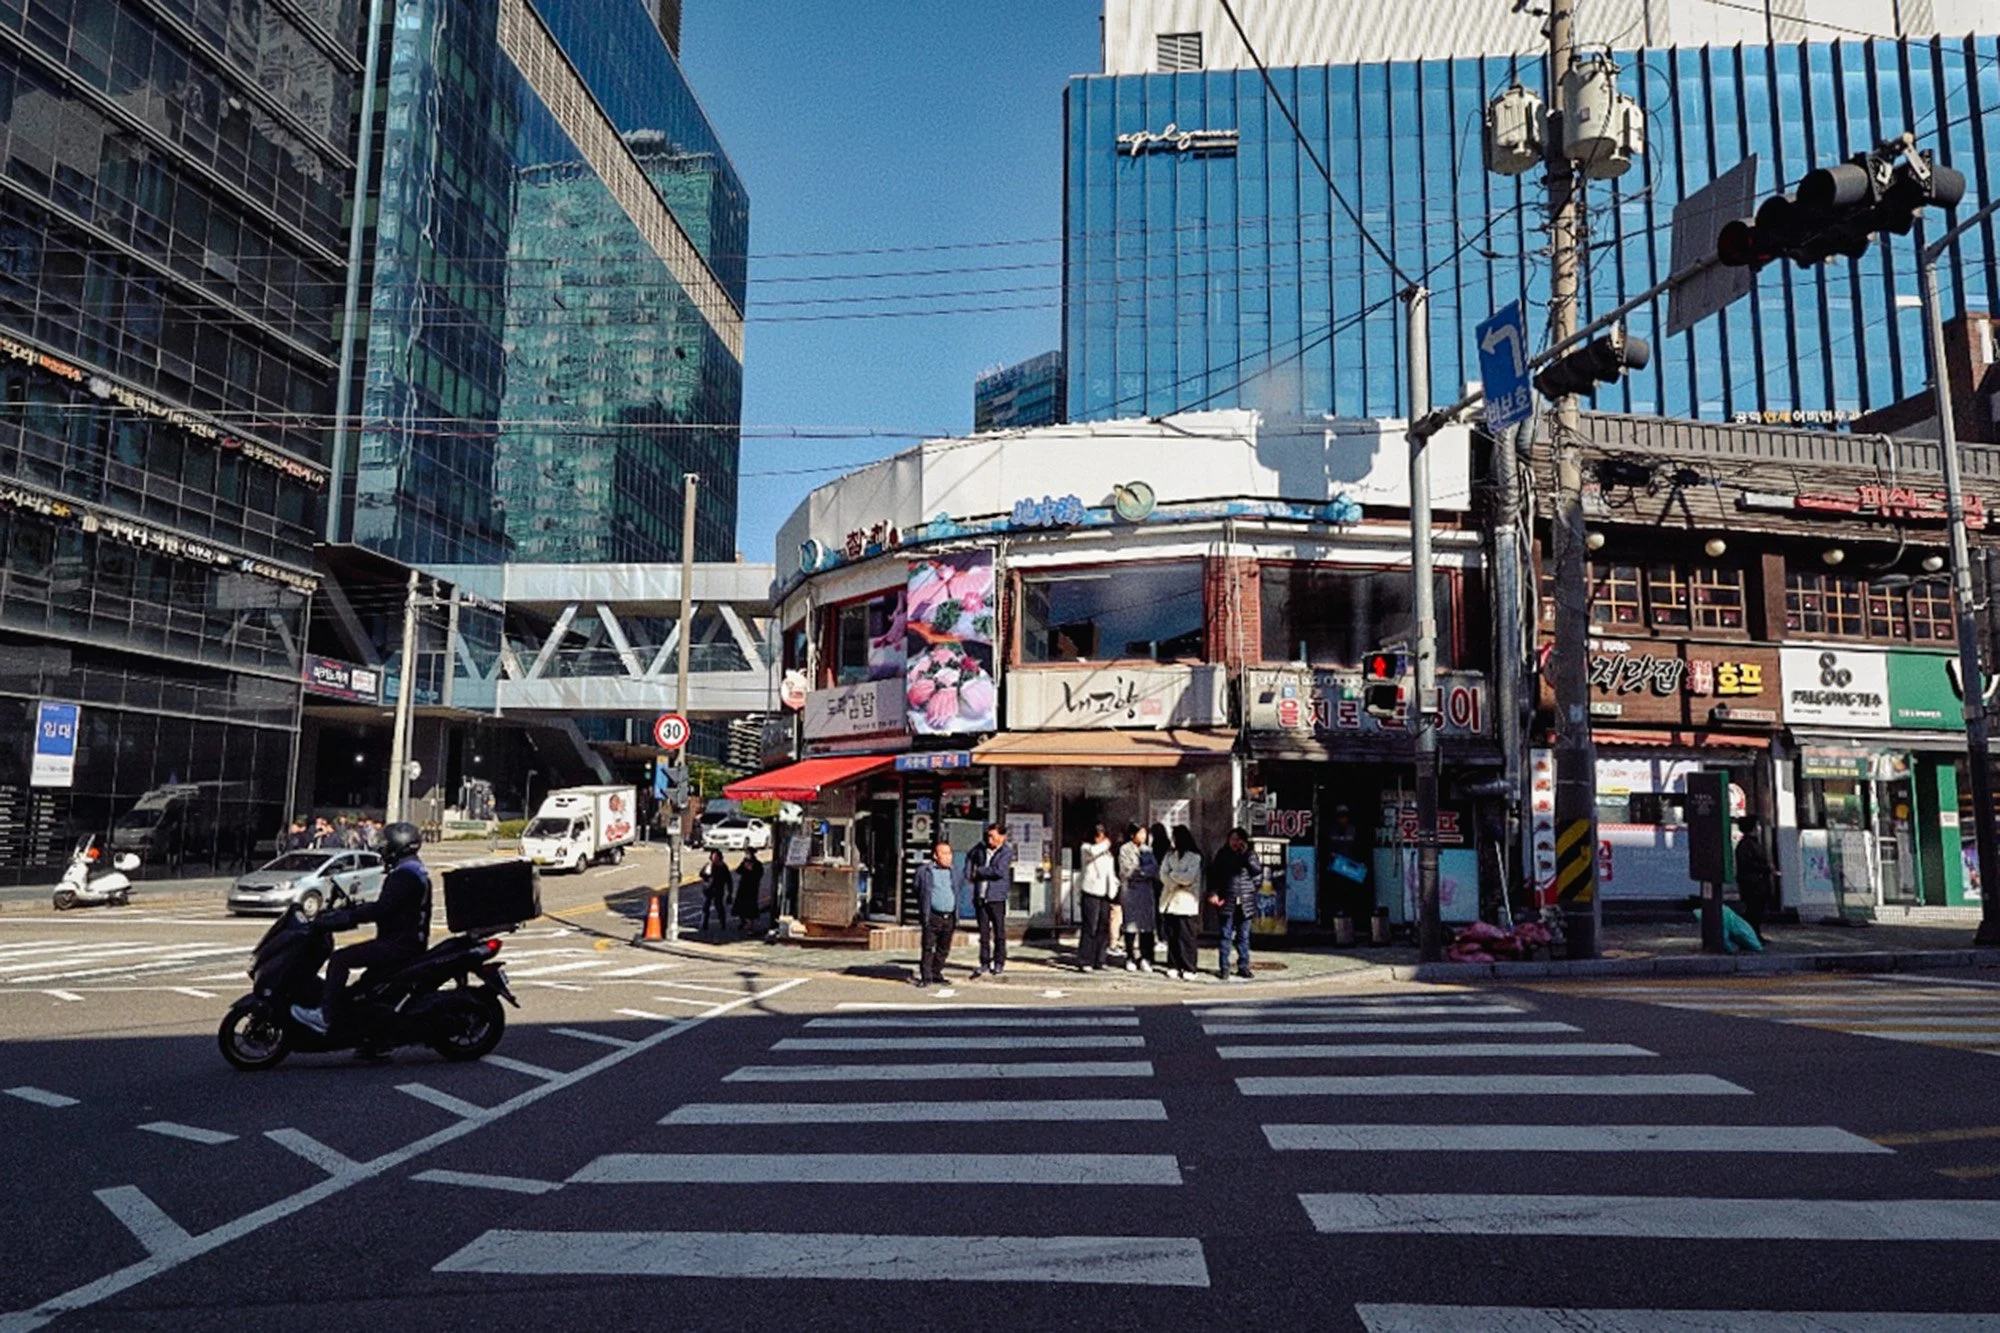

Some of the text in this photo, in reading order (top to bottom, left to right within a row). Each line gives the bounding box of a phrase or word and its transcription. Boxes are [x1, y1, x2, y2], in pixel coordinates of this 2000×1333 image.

[1718, 661, 1764, 694] 호프
[1280, 686, 1482, 732] 을지로이
[44, 721, 72, 739] 임대
[663, 723, 682, 740] 30
[1268, 809, 1313, 837] HOF
